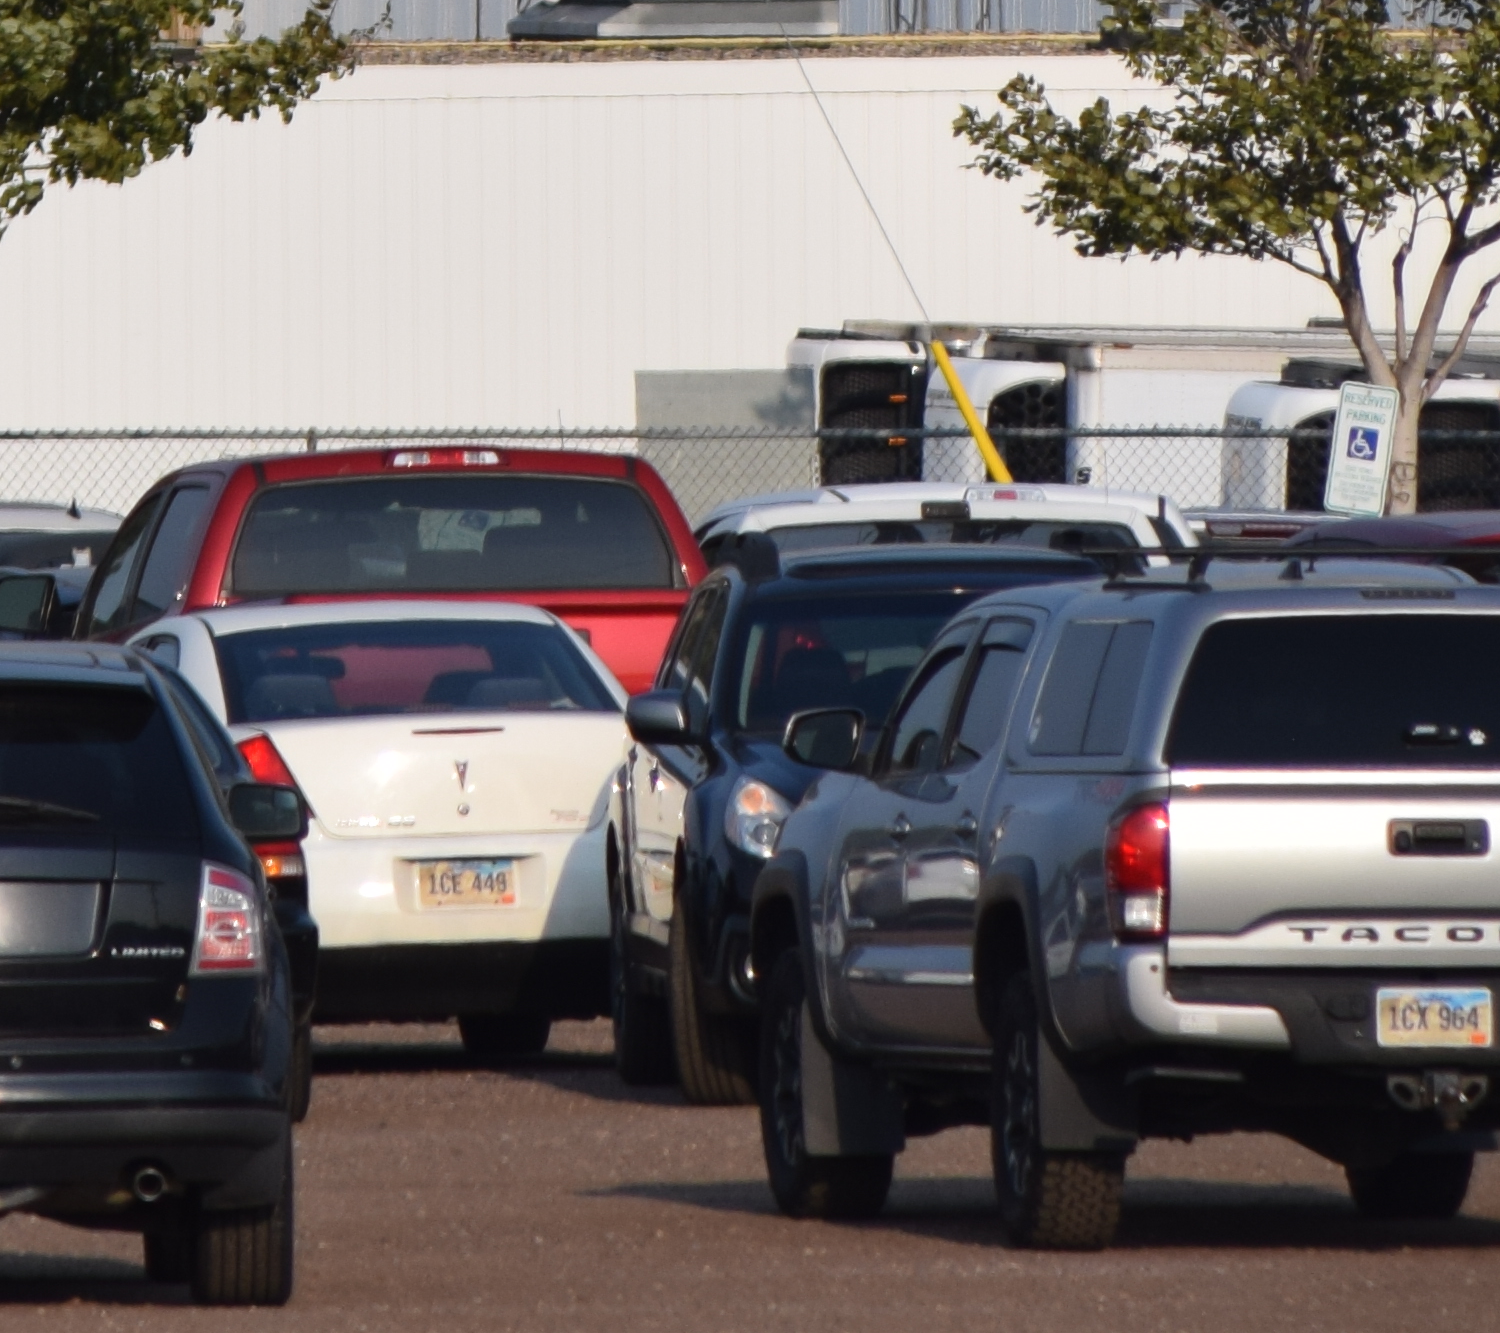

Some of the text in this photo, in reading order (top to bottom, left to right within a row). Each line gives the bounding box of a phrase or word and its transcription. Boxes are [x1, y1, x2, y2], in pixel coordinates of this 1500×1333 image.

[1345, 392, 1393, 409] RESERVED
[1346, 408, 1386, 425] PARKING
[428, 873, 464, 895] 1CE
[111, 946, 185, 958] LIMITED
[1389, 1004, 1480, 1031] 1CX 964
